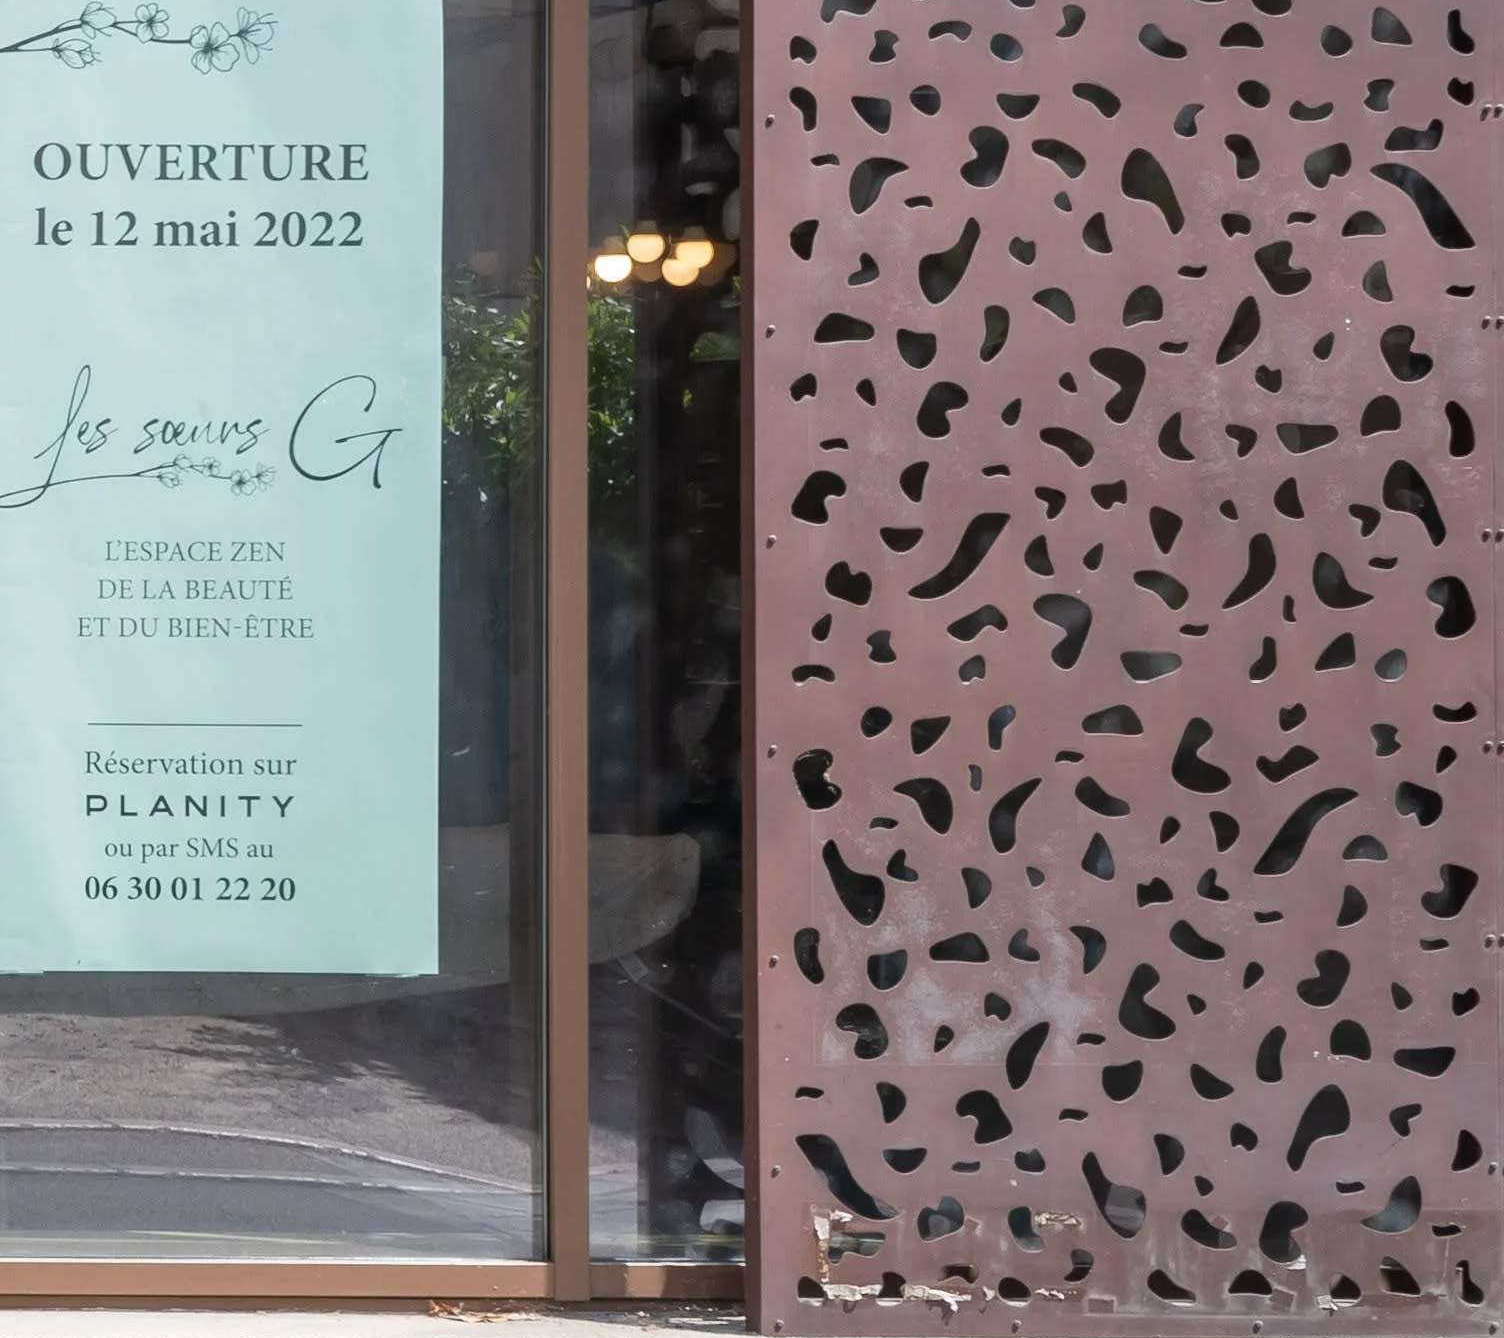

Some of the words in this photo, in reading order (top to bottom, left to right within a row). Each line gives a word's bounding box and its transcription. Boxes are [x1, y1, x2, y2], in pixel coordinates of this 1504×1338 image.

[32, 143, 370, 182] OUVERTURE
[33, 207, 74, 247] le
[90, 210, 139, 247] 12
[153, 209, 241, 248] mai
[253, 210, 364, 248] 2022
[288, 375, 403, 488] G
[230, 541, 285, 562] ZEN
[98, 579, 134, 599] DE
[142, 579, 176, 600] LA
[185, 575, 293, 600] BEAUTÉ
[77, 617, 111, 638] ET
[119, 617, 159, 638] DU
[168, 612, 314, 639] BIEN-ÊTRE
[85, 749, 245, 776] Réservation
[253, 757, 298, 777] sur
[85, 794, 295, 818] PLANITY
[104, 842, 133, 859] ou
[141, 842, 180, 867] par
[186, 836, 240, 859] SMS
[246, 842, 275, 860] au
[84, 876, 118, 901] 06
[127, 876, 162, 901] 30
[170, 876, 204, 901] 01
[215, 876, 251, 901] 22
[260, 877, 296, 902] 20
